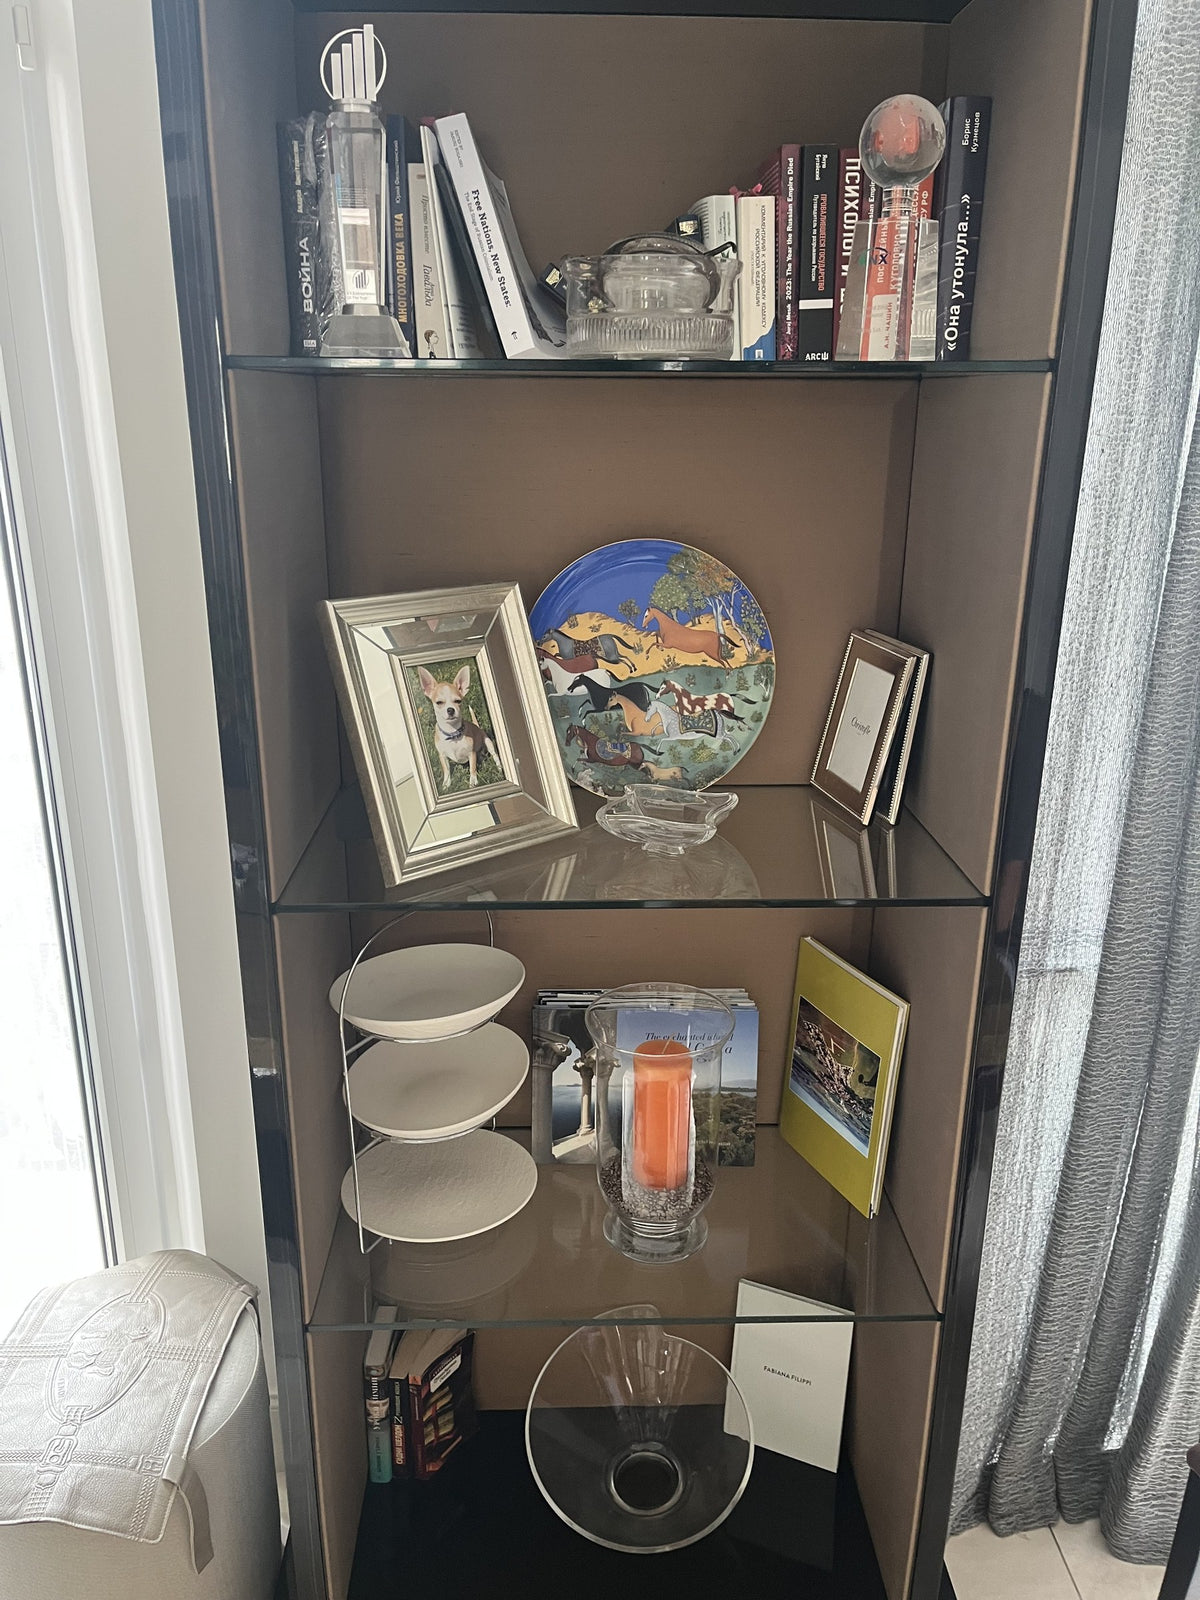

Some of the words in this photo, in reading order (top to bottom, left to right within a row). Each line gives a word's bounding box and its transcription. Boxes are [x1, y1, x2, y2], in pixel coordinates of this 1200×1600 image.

[961, 118, 972, 146] Борис
[970, 112, 981, 153] Кузнецов
[471, 189, 485, 211] Free
[787, 176, 795, 202] Empire
[868, 180, 876, 202] Empir
[922, 190, 929, 206] РФ
[421, 194, 430, 224] Просто
[469, 212, 479, 227] Stage
[786, 204, 794, 232] Russian
[818, 194, 828, 248] ПРОВАЛИВШЕЕСЯ
[394, 213, 404, 239] ВЕКА
[476, 212, 498, 253] Nations,
[950, 192, 971, 300] утонула...»
[298, 237, 314, 314] ВОЙНА
[490, 253, 504, 275] New
[810, 264, 818, 282] России
[818, 248, 827, 290] ГОСУДАРСТВО
[396, 241, 408, 322] МНОГОХОДОВКА
[423, 264, 434, 306] Гавальда
[496, 276, 514, 308] States:
[944, 305, 962, 352] «Она
[851, 716, 872, 736] Christofle
[645, 1032, 661, 1041] The
[763, 1366, 791, 1380] FABIANA
[790, 1374, 812, 1386] FILIPPI
